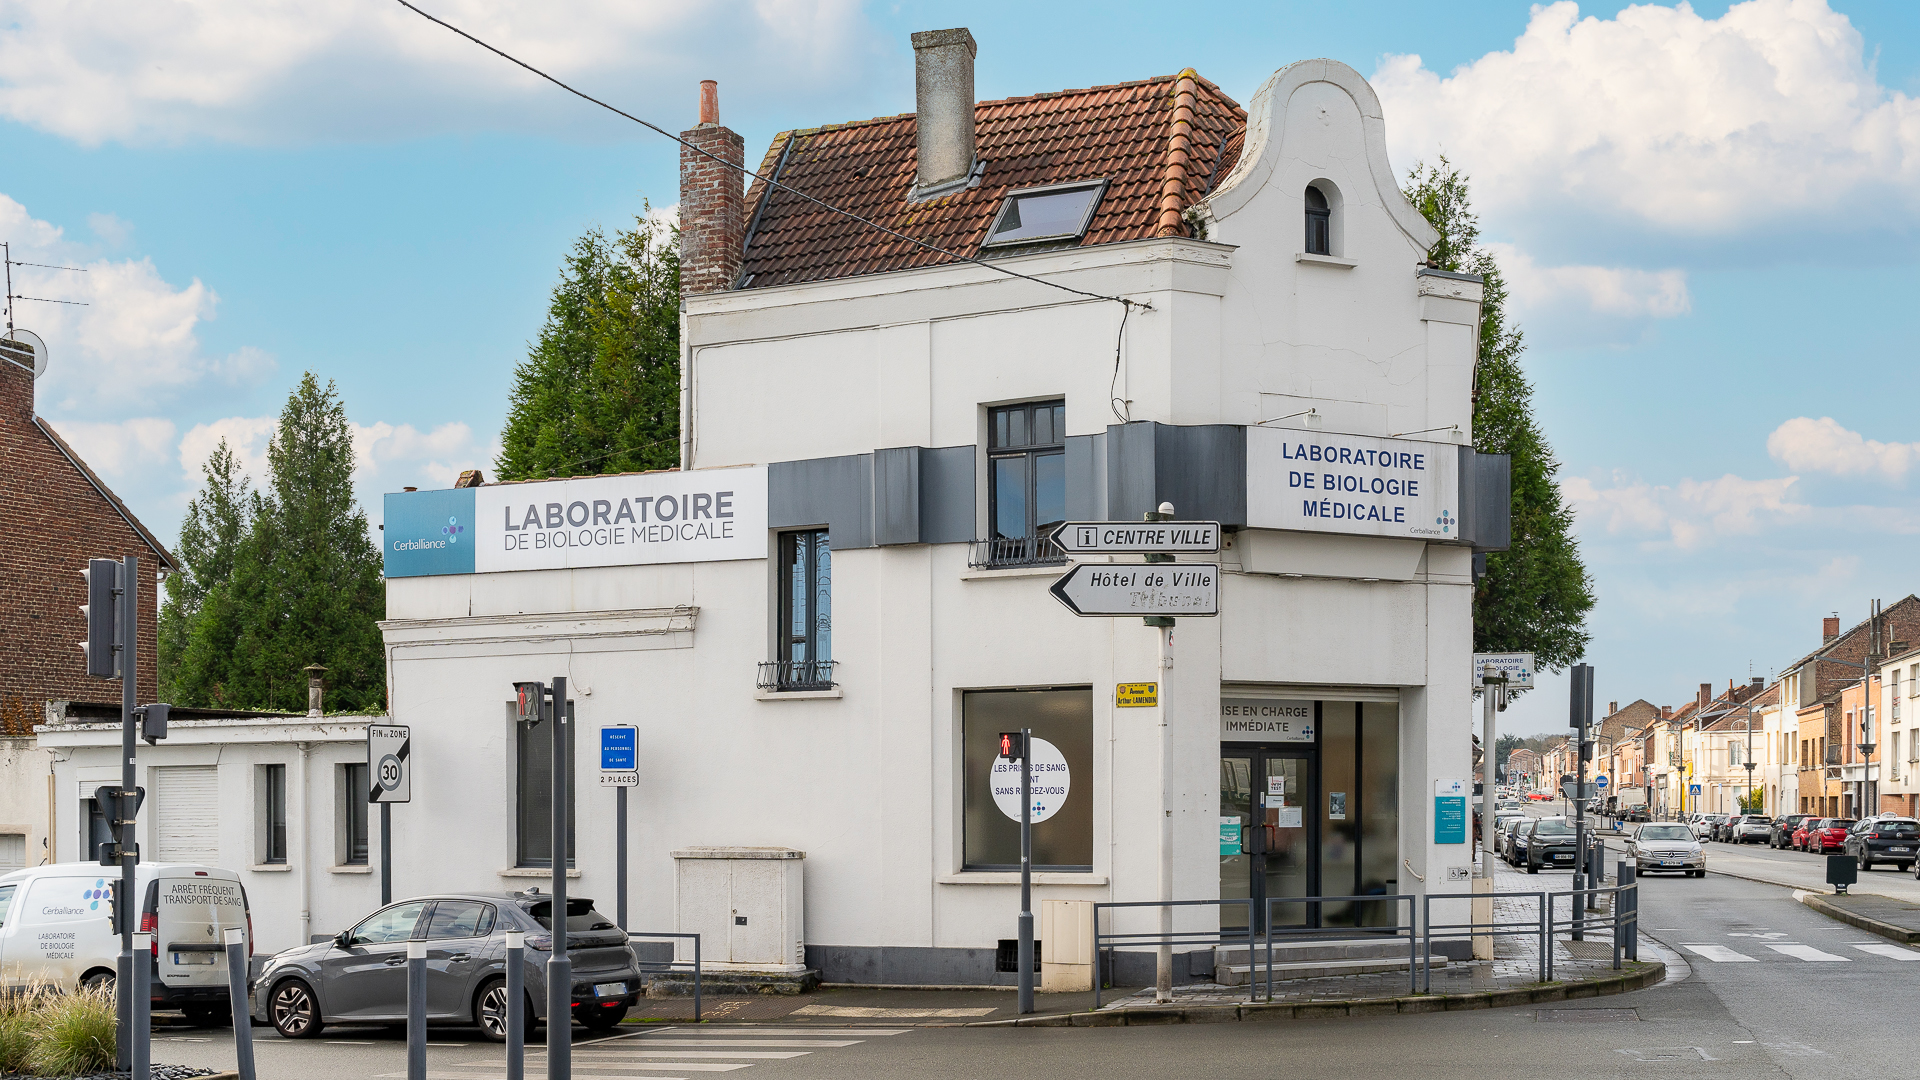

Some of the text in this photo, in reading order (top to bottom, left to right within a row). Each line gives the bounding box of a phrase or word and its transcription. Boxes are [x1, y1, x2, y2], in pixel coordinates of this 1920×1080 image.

[1282, 442, 1425, 470] LABORATOIRE
[1289, 471, 1418, 497] DE BIOLOGIE
[505, 491, 734, 531] LABORATOIRE
[1303, 497, 1405, 523] MÉDICALE
[505, 521, 734, 551] DE BIOLOGIE MÉDICALE
[1103, 529, 1165, 545] CENTRE
[1170, 529, 1211, 545] VILLE
[1410, 526, 1441, 536] Cerballiance
[393, 538, 447, 552] Cerballiance
[1091, 572, 1211, 587] Hôtel de Ville
[1242, 706, 1258, 716] EN
[1261, 706, 1308, 718] CHARGE
[1226, 719, 1289, 732] IMMÉDIATE
[372, 729, 383, 737] FIN
[390, 730, 407, 738] ZONE
[383, 764, 398, 781] 30
[994, 764, 1007, 773] LES
[1035, 763, 1045, 772] DE
[1046, 763, 1066, 772] SANG
[995, 786, 1065, 795] SANS RDEZ-VOUS
[171, 882, 235, 895] ARRÊT FRÉQUENT
[163, 894, 242, 907] TRANSPORT DE SANG
[42, 905, 84, 916] Cerballiance
[38, 932, 76, 940] LABORATOIRE
[40, 941, 75, 950] DE BIOLOGIE
[45, 951, 74, 959] MÉDICALE
